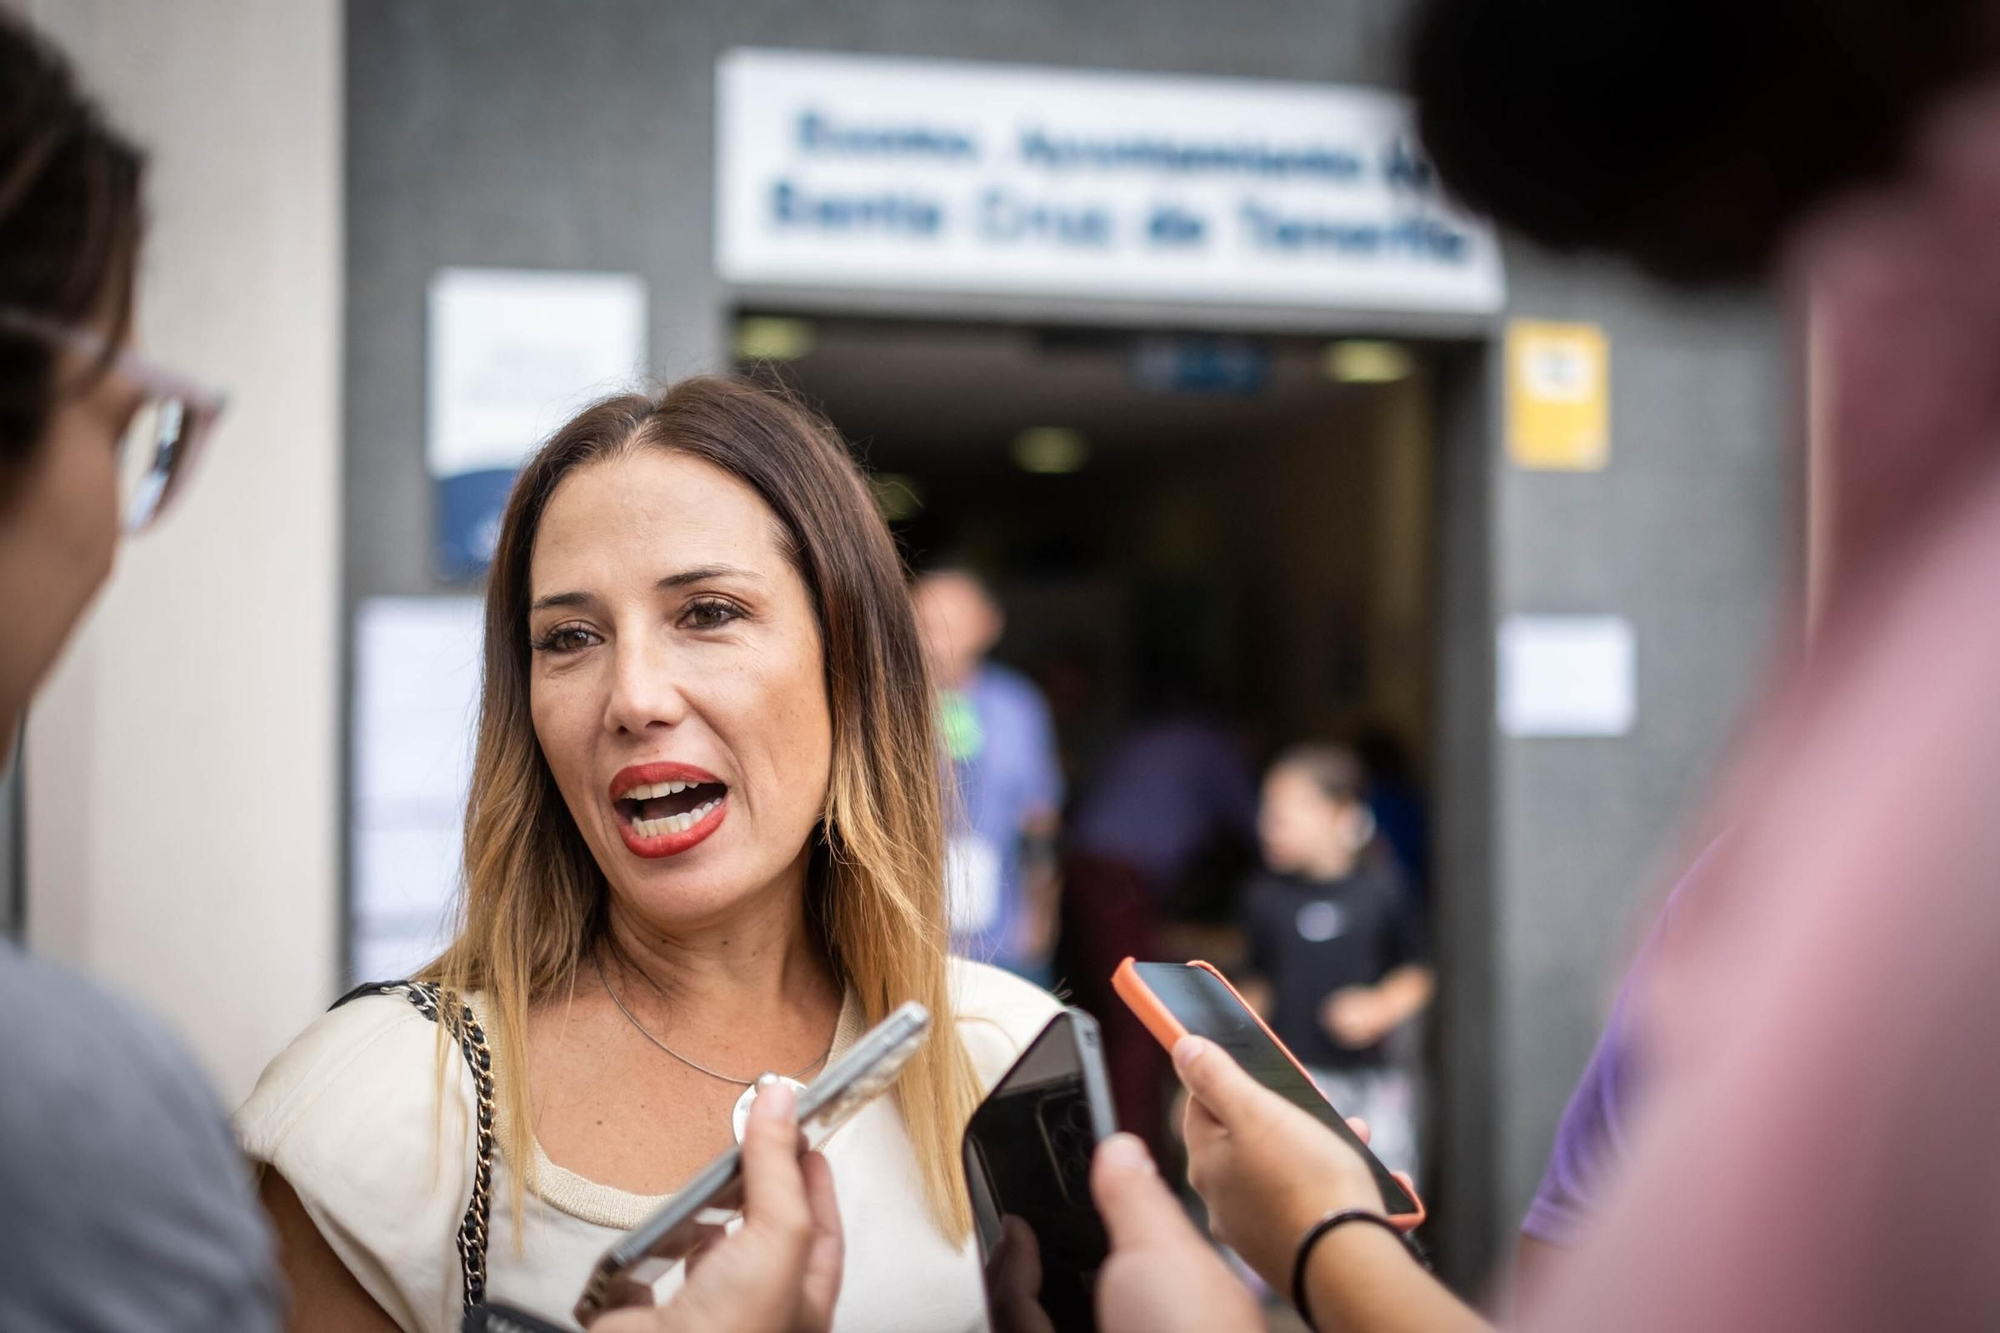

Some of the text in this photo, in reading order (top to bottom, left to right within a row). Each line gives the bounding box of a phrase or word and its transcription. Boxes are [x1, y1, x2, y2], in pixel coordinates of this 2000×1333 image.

[1018, 126, 1362, 183] Ayuntamiento
[773, 178, 1464, 260] Santa Cruz de Tenerife
